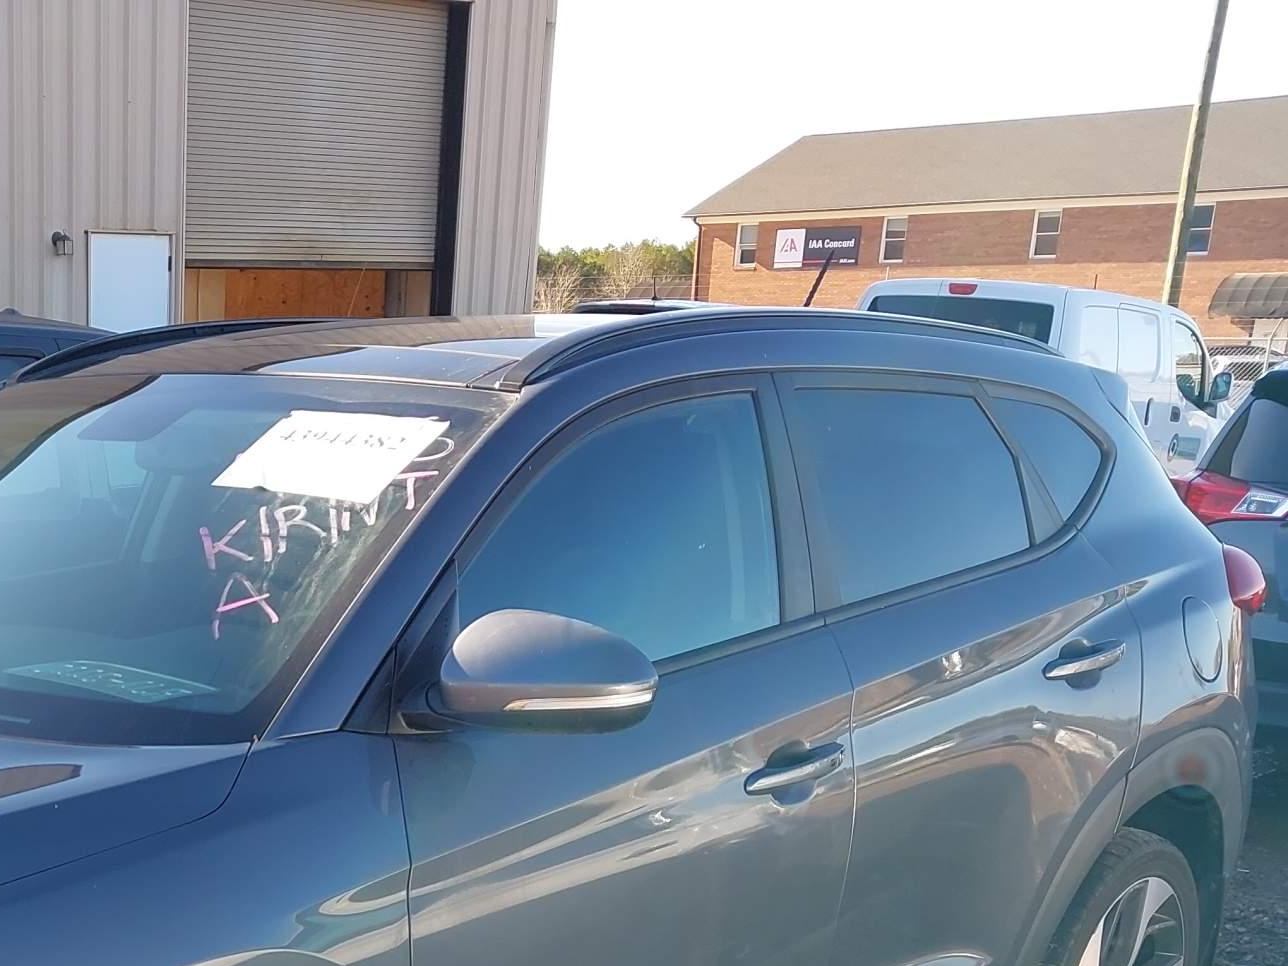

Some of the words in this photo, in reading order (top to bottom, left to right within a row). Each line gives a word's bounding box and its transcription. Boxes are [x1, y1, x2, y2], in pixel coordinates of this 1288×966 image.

[808, 239, 823, 249] IAA
[824, 238, 856, 249] Concord
[214, 571, 280, 640] A
